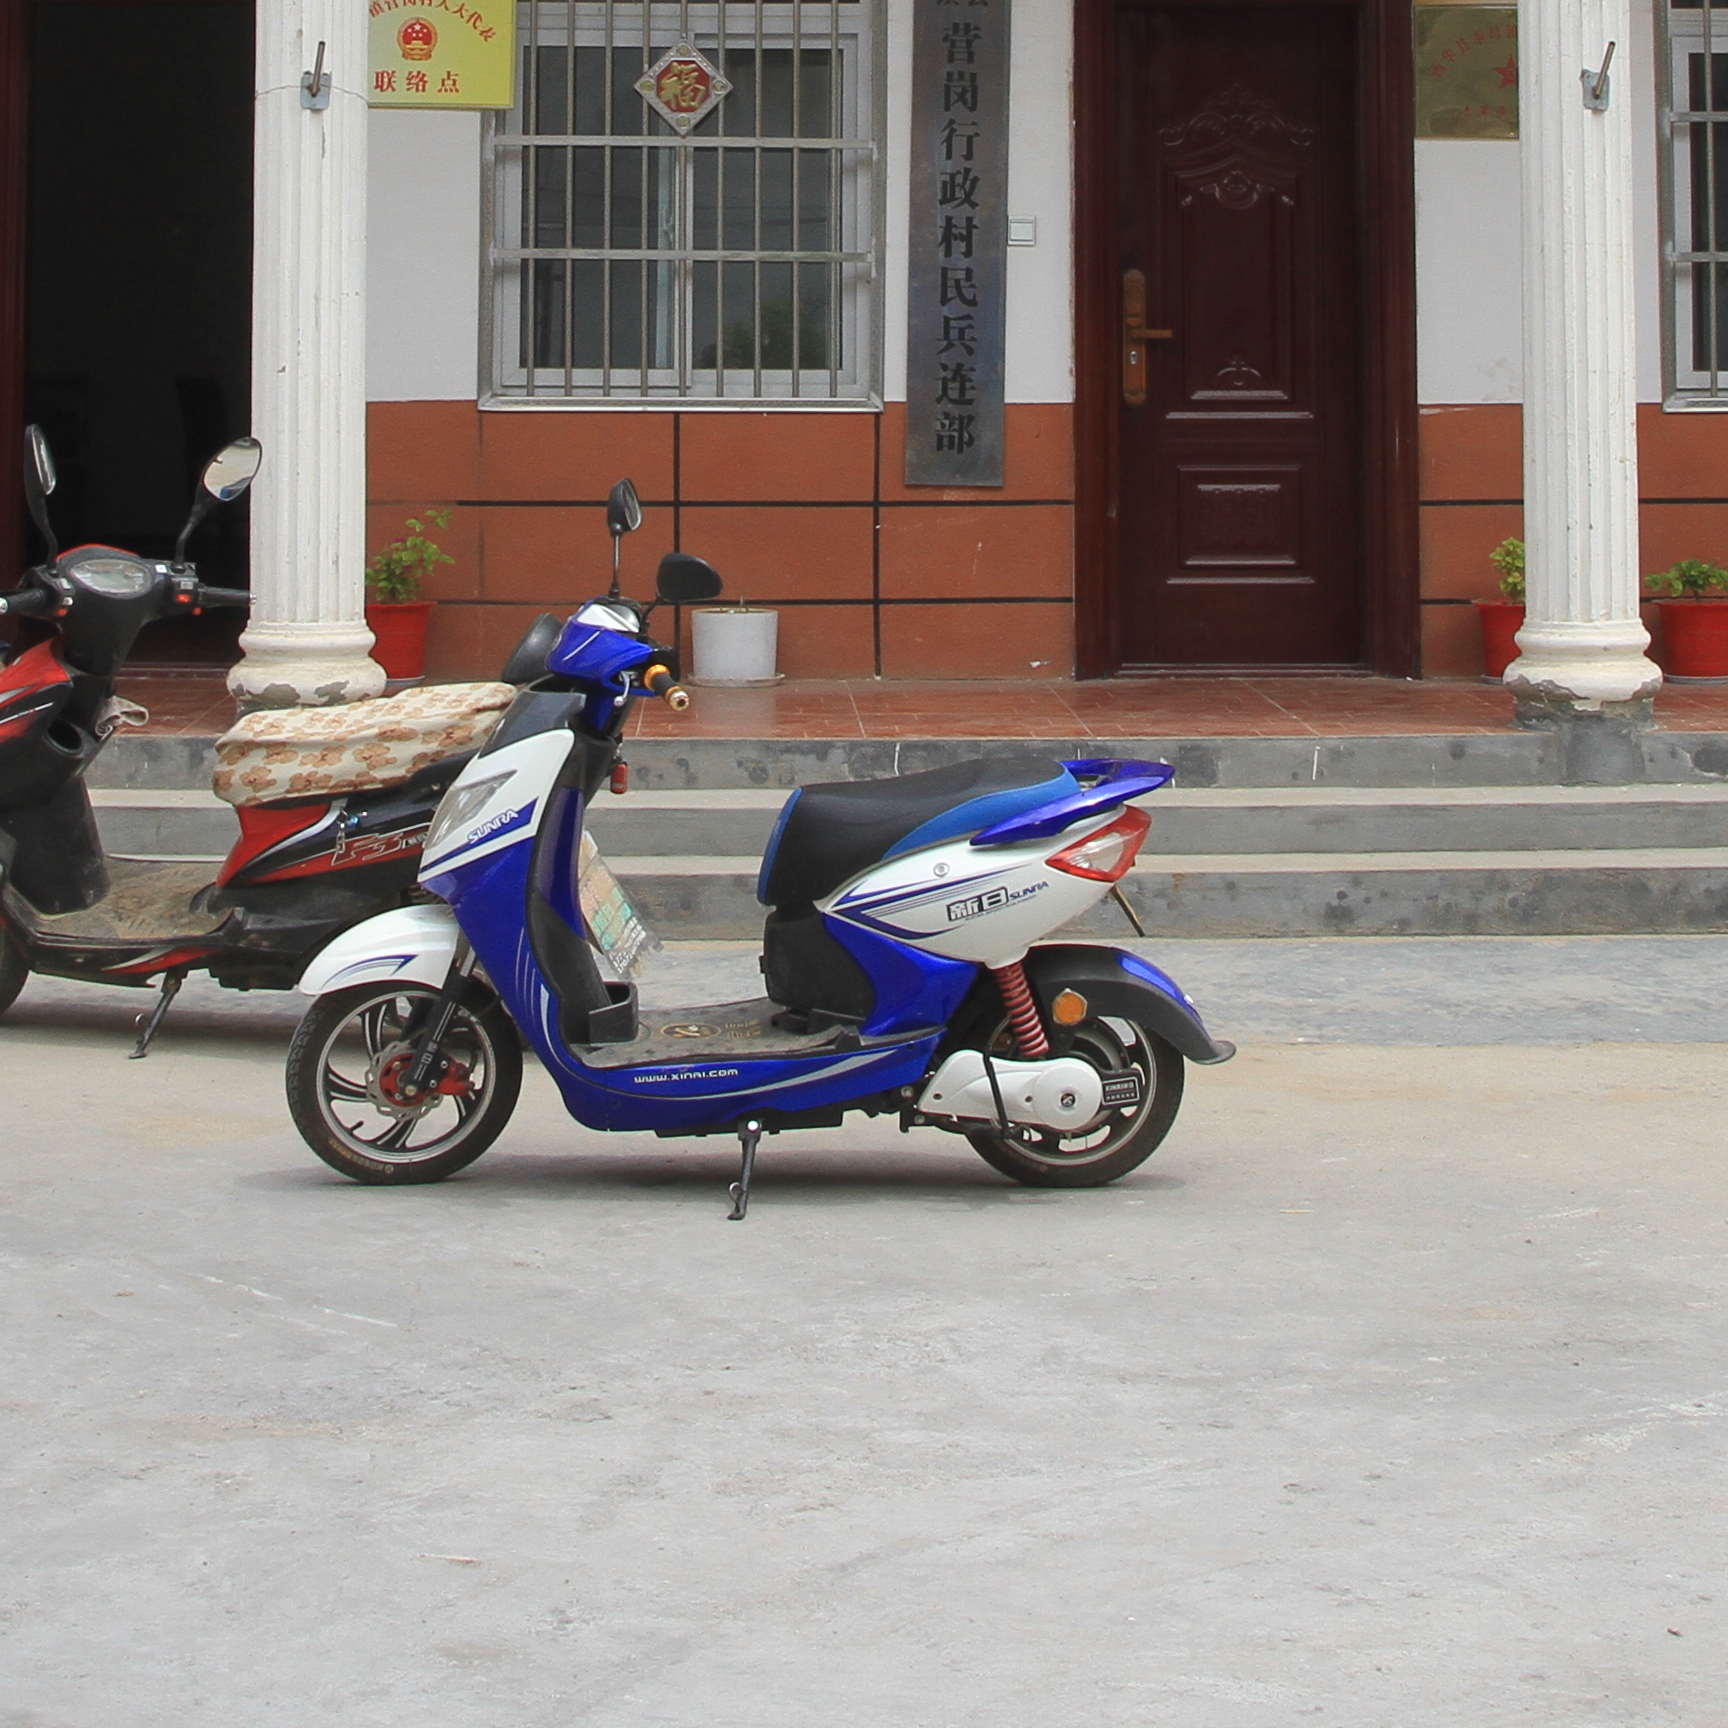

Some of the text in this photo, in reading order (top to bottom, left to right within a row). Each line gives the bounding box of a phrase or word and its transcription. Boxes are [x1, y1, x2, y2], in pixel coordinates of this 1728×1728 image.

[373, 70, 460, 94] 联络点
[659, 62, 706, 109] 福
[934, 22, 982, 455] 营岗行政村民兵连部
[466, 808, 519, 845] SUNRA
[947, 885, 1010, 922] 新日
[1009, 880, 1049, 899] SUNRA
